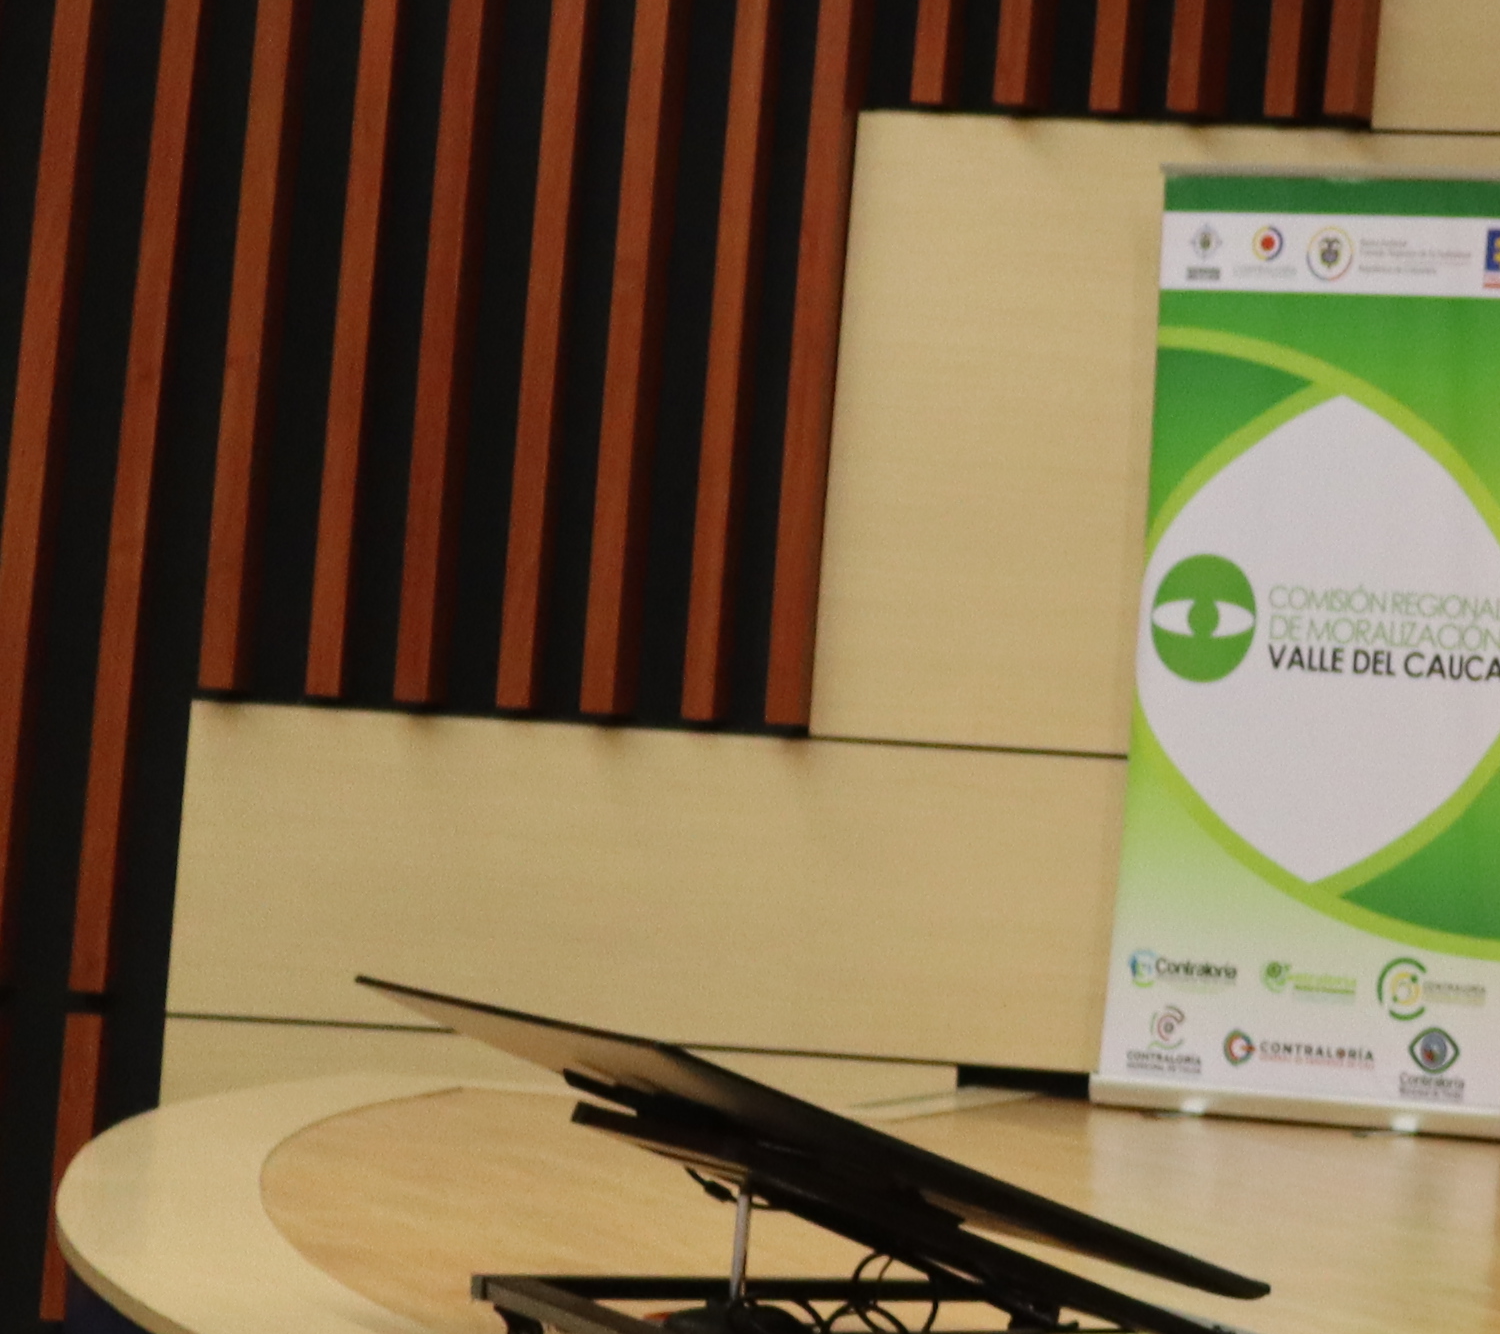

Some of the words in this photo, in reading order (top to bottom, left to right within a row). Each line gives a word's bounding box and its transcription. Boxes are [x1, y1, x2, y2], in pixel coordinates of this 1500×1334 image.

[1268, 583, 1388, 616] COMISIÓN
[1268, 614, 1302, 642] DE
[1268, 643, 1346, 674] VALLE
[1352, 648, 1396, 677] DEL
